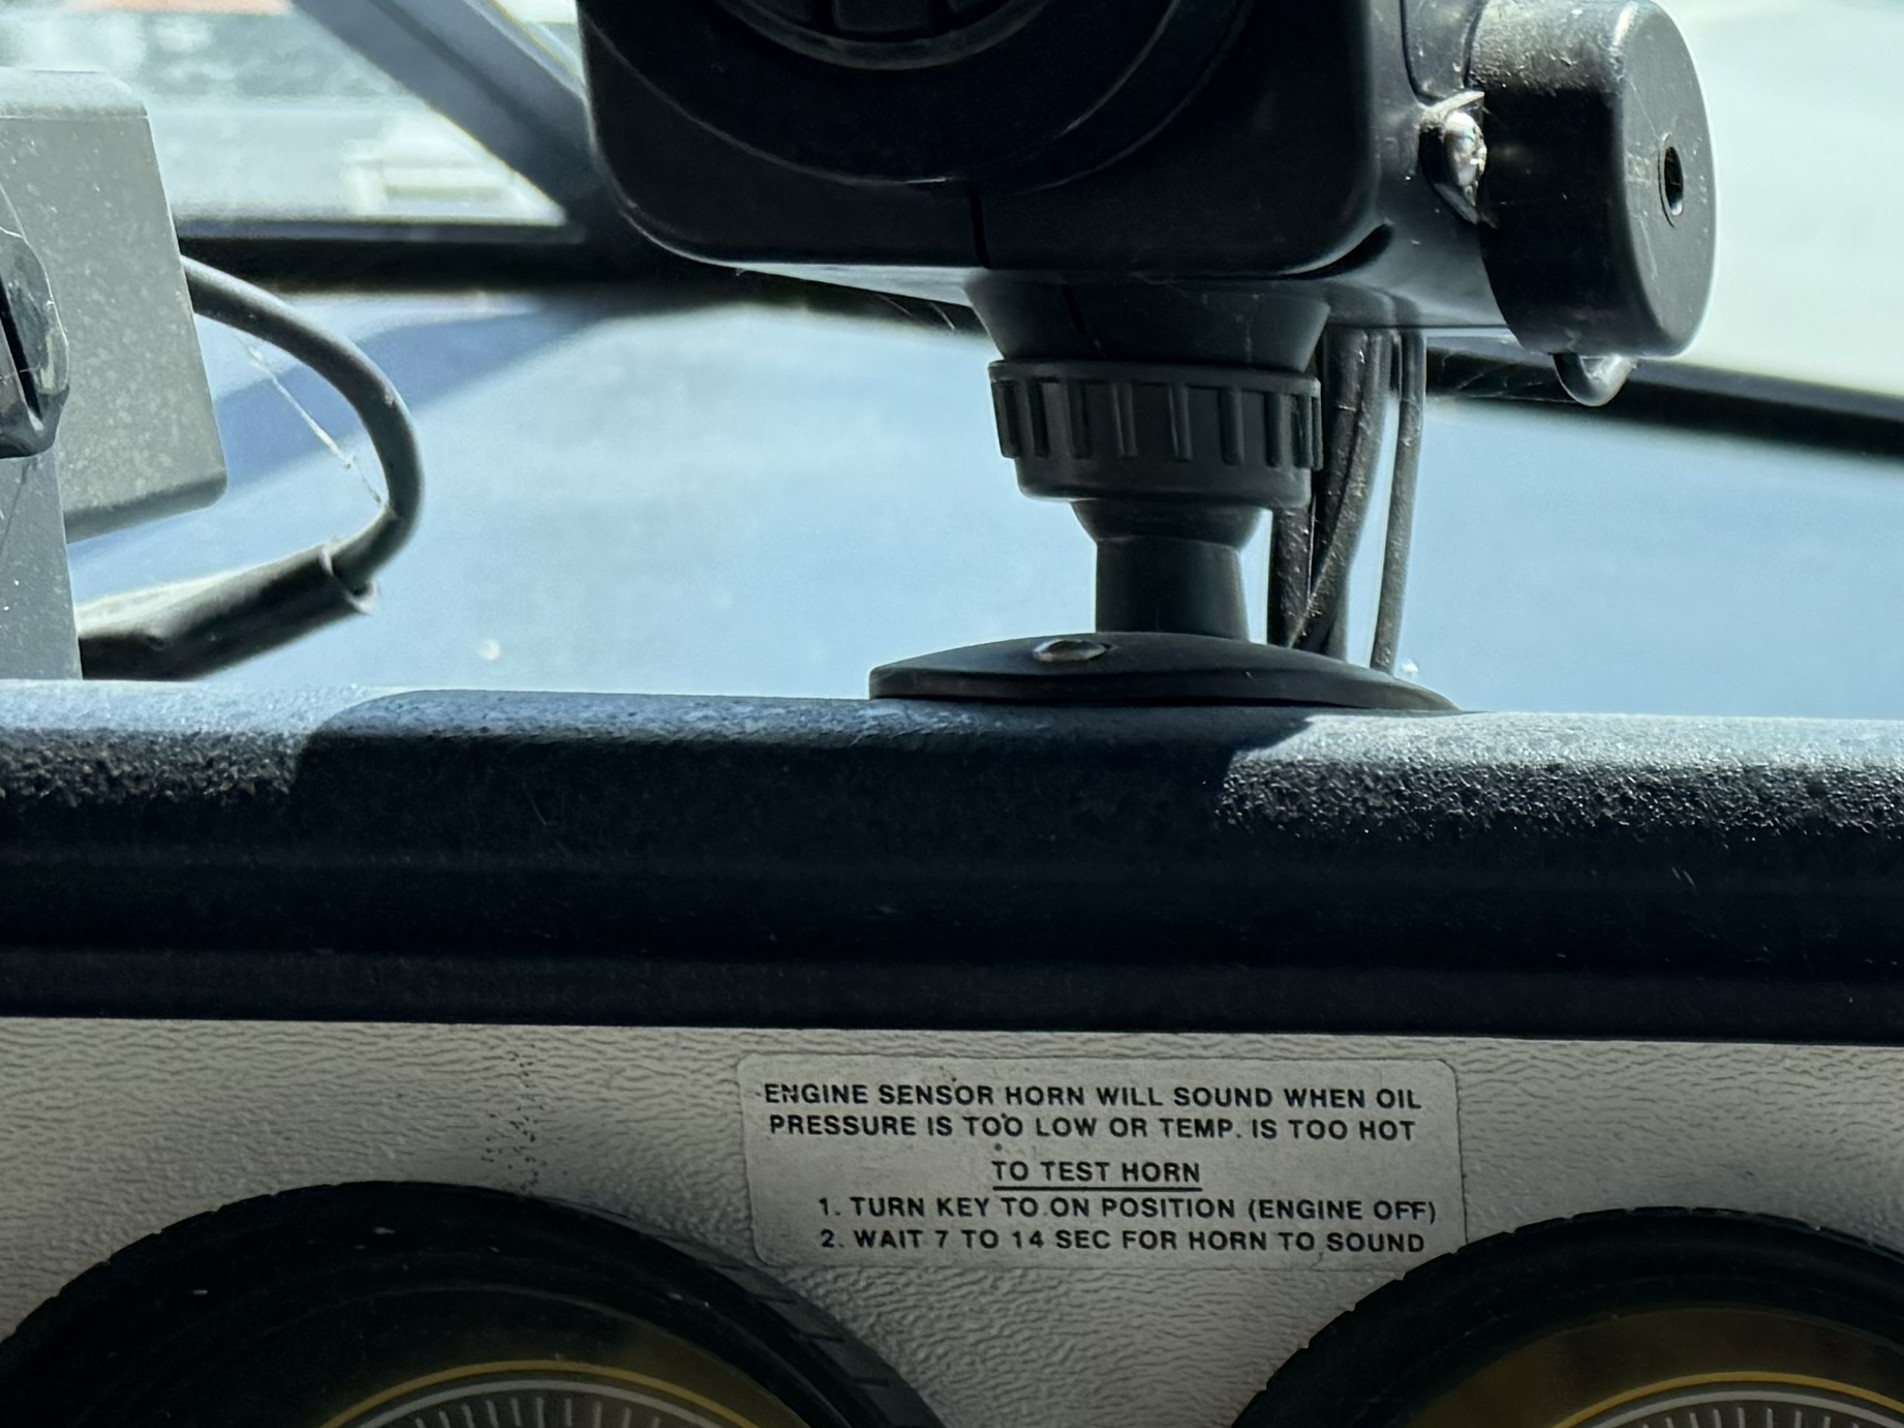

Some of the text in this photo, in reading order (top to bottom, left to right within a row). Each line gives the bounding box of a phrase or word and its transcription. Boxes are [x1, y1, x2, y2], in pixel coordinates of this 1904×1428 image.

[765, 1083, 1422, 1109] ENGINE SENSOR HORN WILL SOUND WHEN OIL
[770, 1115, 1415, 1141] PRESSURE IS TOO LOW OR TEMP. IS TOO HOT
[992, 1161, 1200, 1183] TO TEST HORN
[819, 1197, 1436, 1224] 1. TURN KEY TO ON POSITION (ENGINE OFF)
[820, 1229, 1424, 1252] 2. WAIT 7 TO 14 SEC FOR HORN TO SOUND
